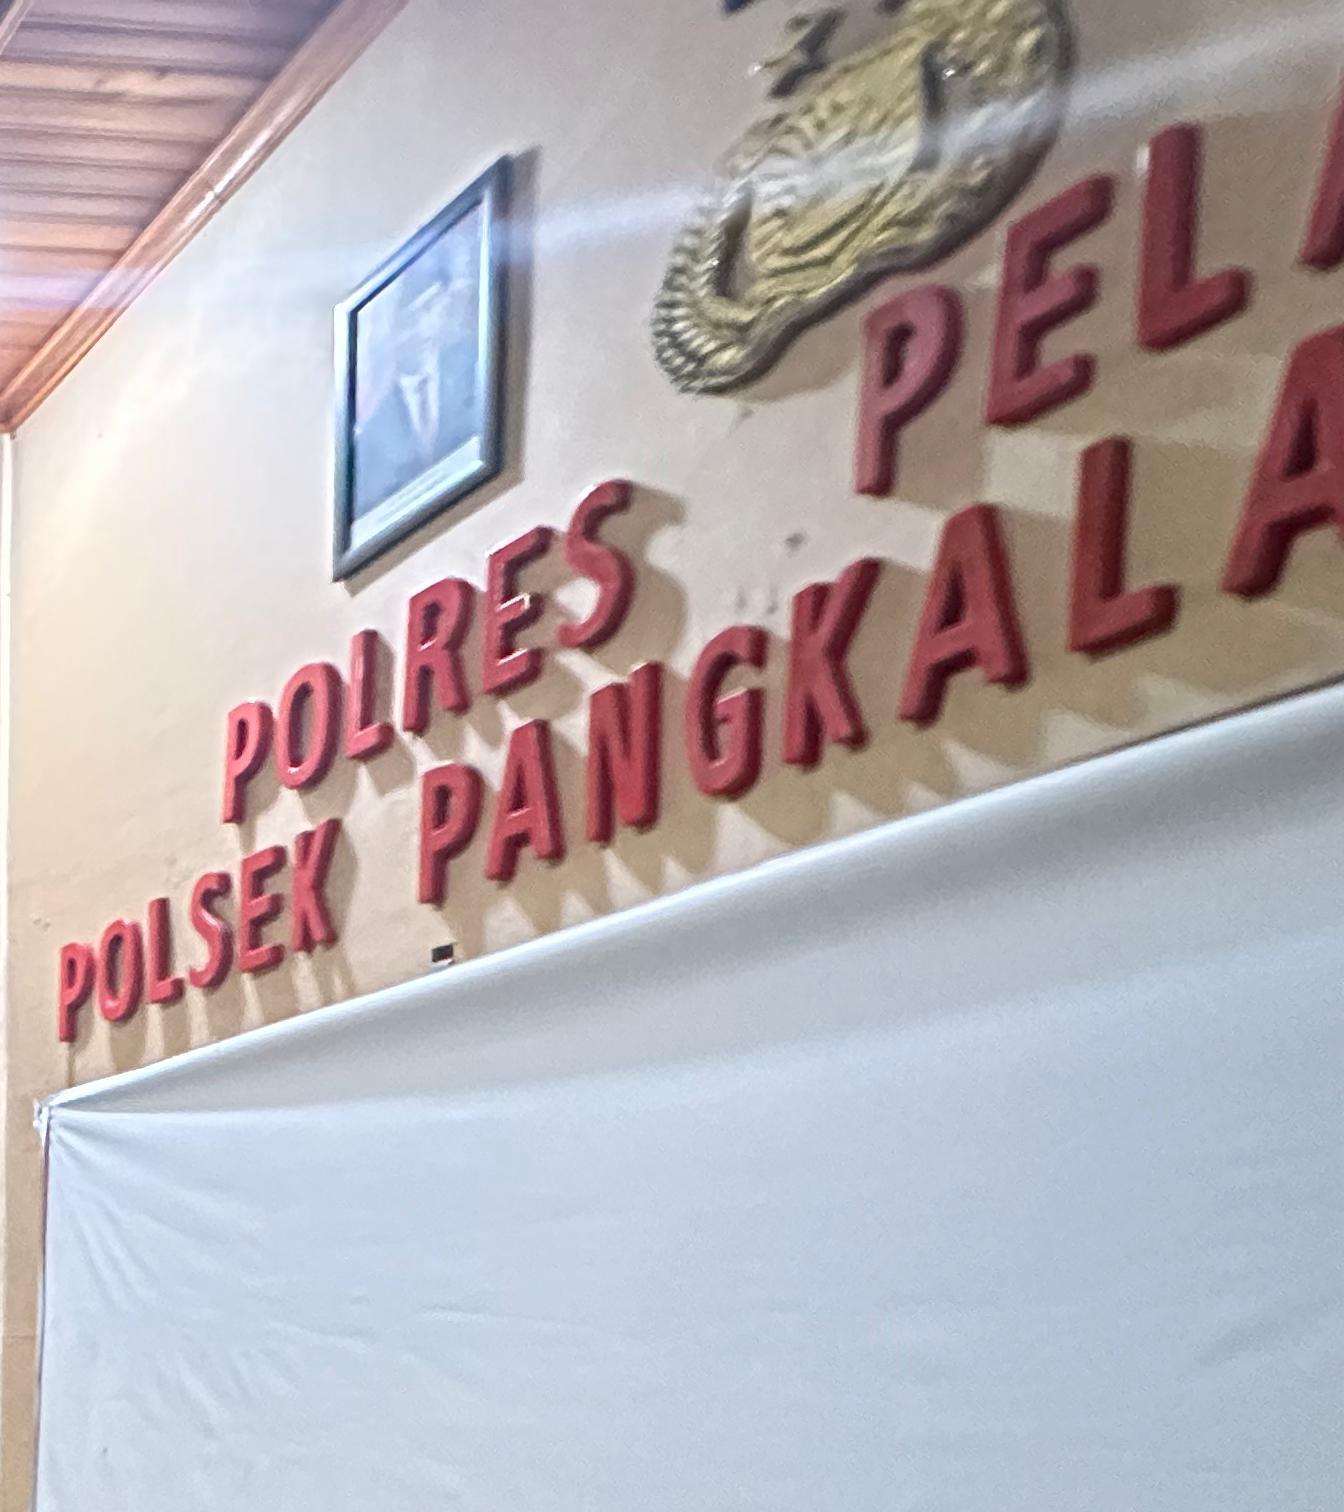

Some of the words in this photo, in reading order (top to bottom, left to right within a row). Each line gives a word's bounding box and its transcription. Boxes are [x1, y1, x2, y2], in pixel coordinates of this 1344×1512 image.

[58, 818, 342, 1042] POLSEK
[418, 322, 1344, 908] PANGKALA
[222, 479, 634, 826] POLRES
